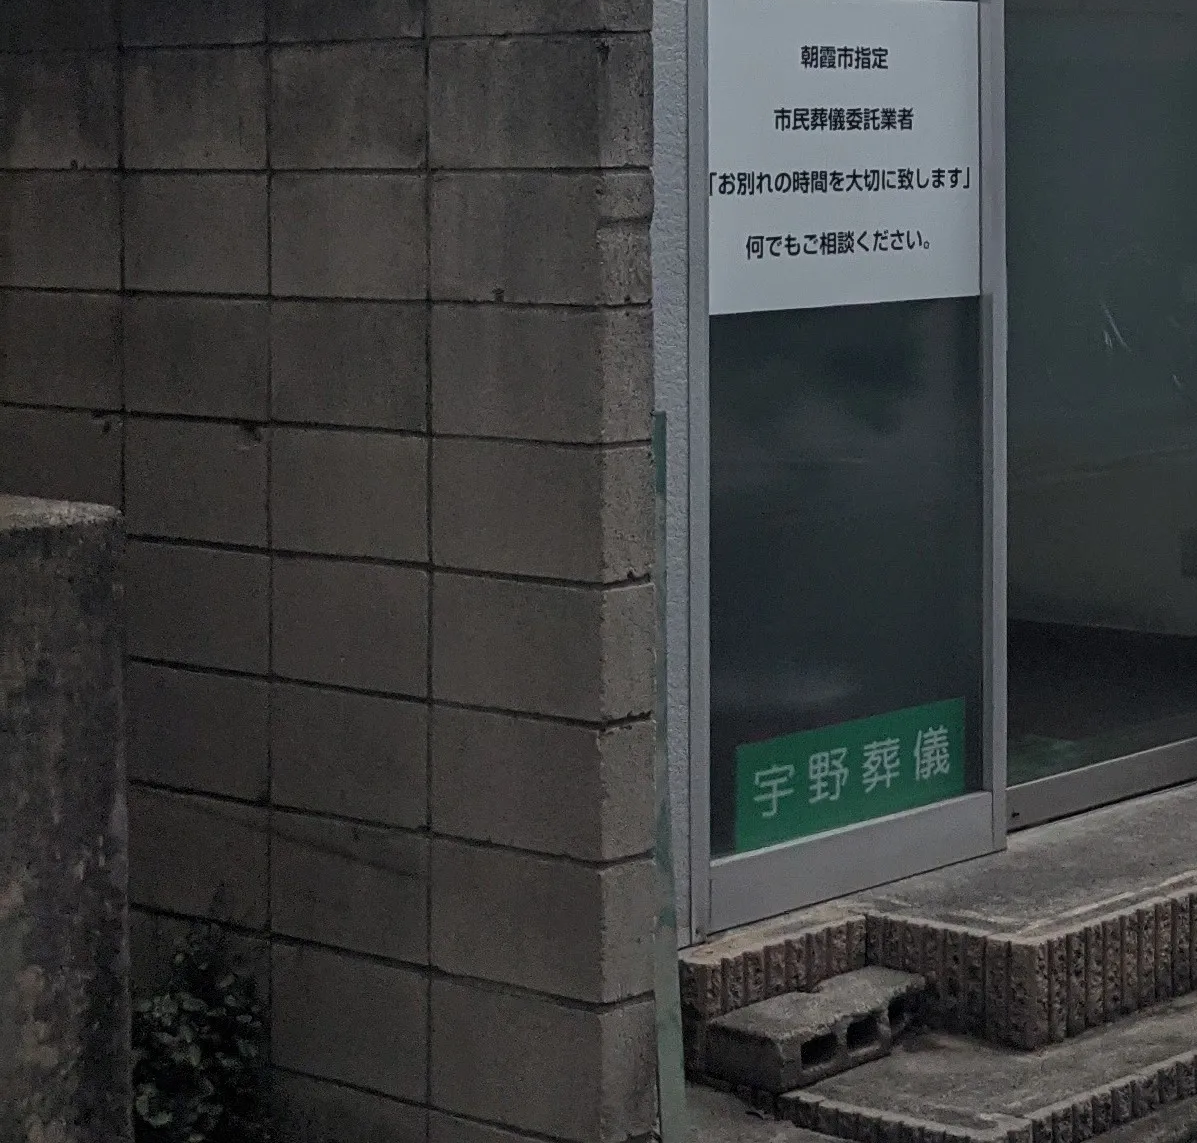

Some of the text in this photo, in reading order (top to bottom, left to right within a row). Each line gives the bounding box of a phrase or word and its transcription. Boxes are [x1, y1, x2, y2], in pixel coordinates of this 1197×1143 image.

[800, 45, 889, 69] 朝霞市指定
[774, 107, 914, 131] 市民葬儀委託業者
[709, 167, 970, 196] 「お別れの時間を大切に致します」
[746, 230, 930, 260] 何でもご相談ください。
[753, 724, 950, 818] 宇野葬儀
